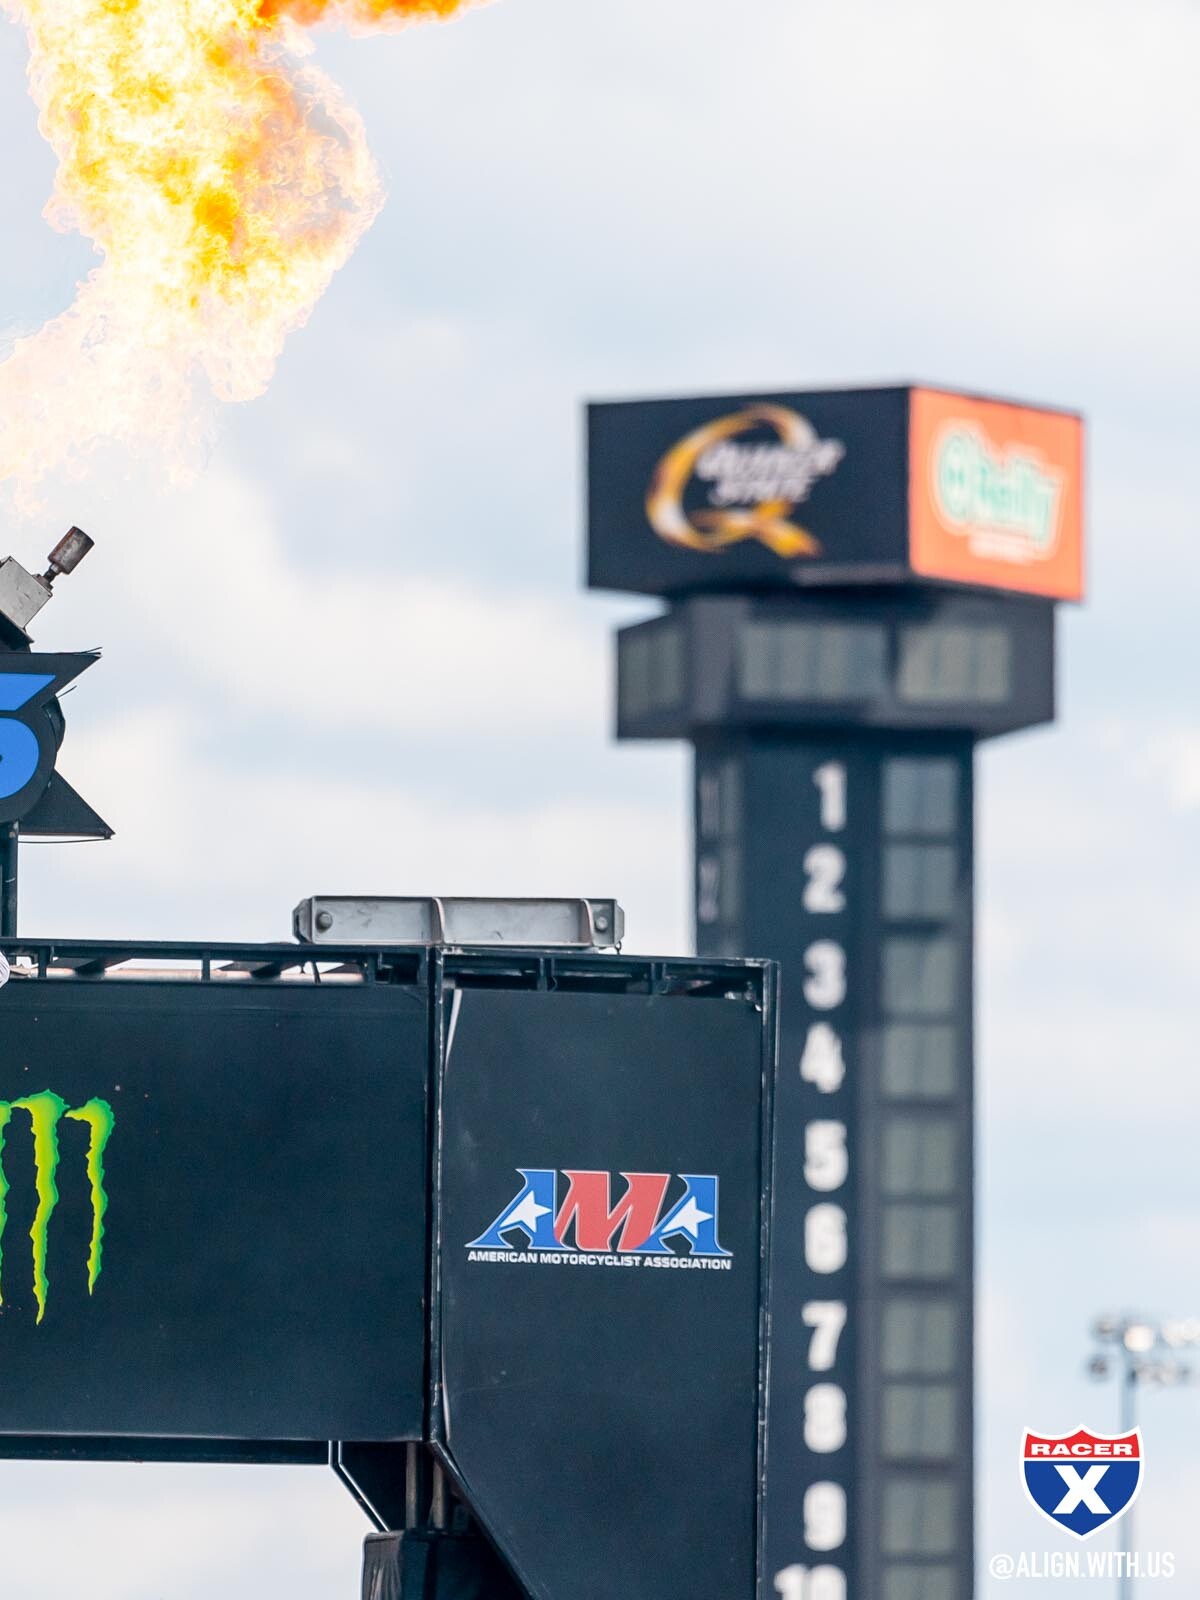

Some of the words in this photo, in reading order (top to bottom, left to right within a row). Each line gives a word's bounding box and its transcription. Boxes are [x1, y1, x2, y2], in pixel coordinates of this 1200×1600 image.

[813, 760, 847, 831] 1
[803, 843, 847, 914] 2
[803, 939, 847, 1011] 3
[800, 1022, 846, 1094] 4
[804, 1119, 848, 1192] 5
[464, 1168, 734, 1257] AMA
[467, 1250, 538, 1264] AMERICAN
[539, 1253, 641, 1267] MOTORCYCLIST
[643, 1257, 732, 1271] ASSOCIATION
[801, 1302, 848, 1372] 7
[803, 1382, 847, 1453] 8
